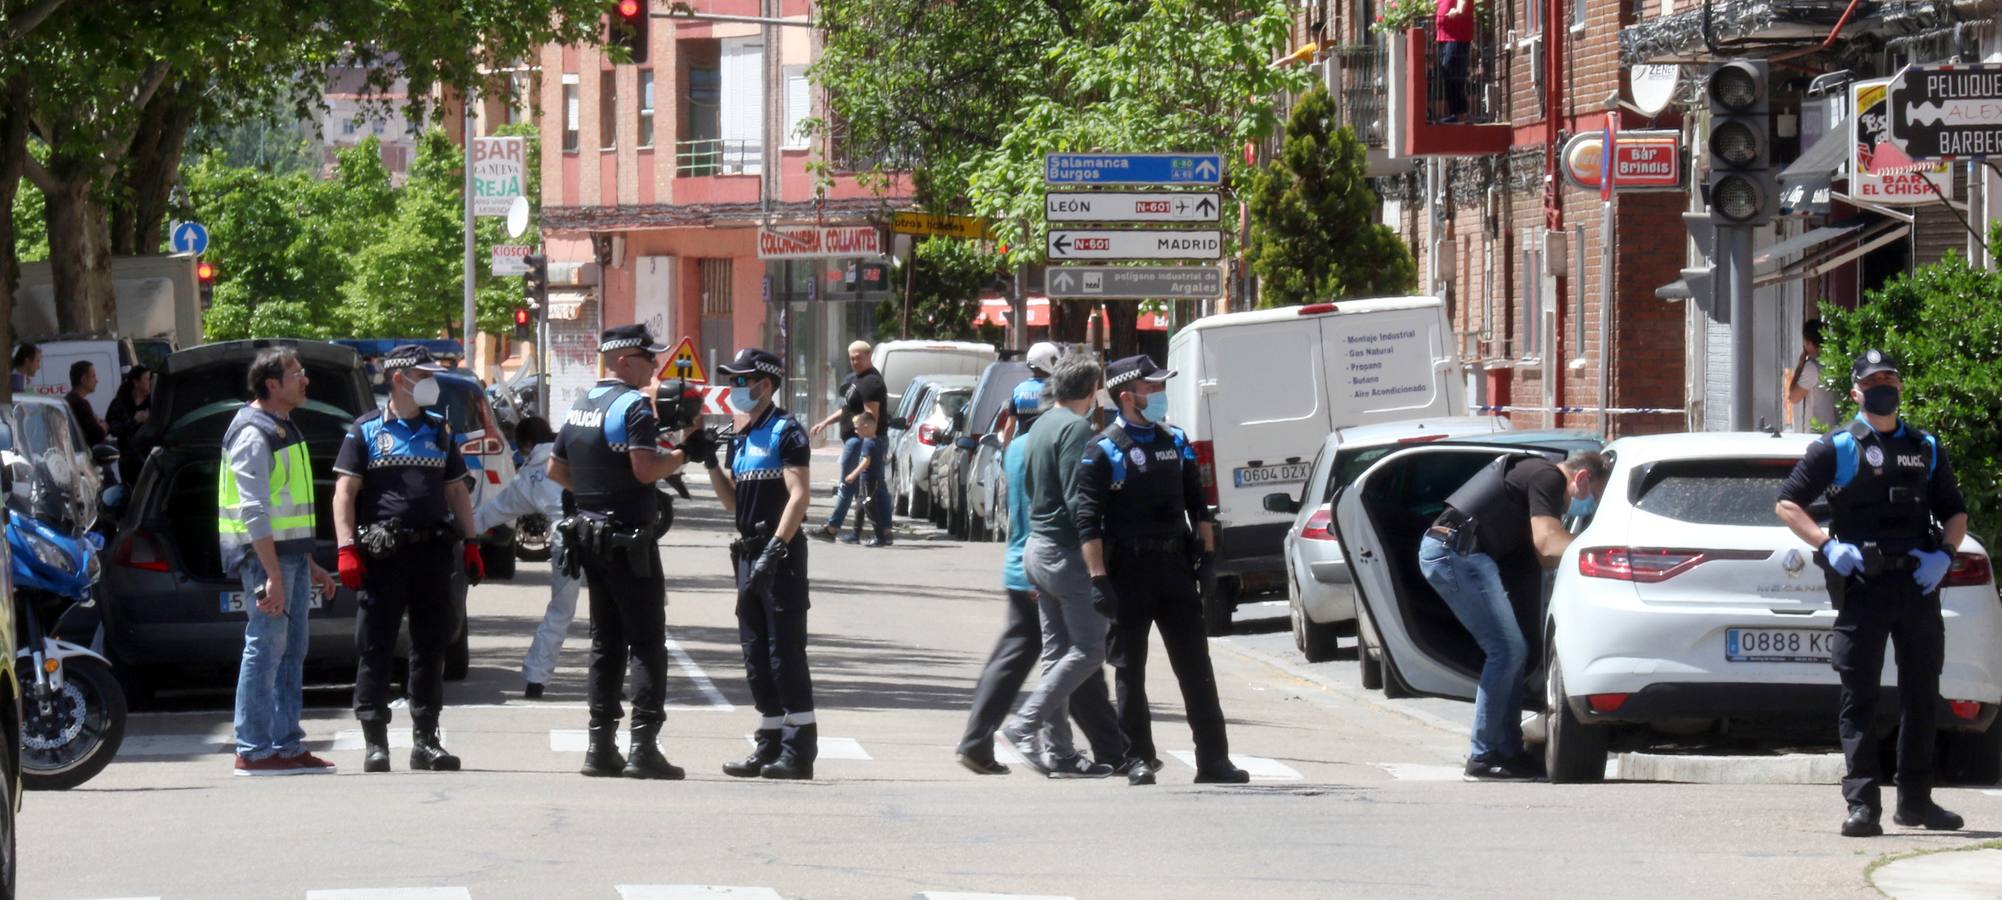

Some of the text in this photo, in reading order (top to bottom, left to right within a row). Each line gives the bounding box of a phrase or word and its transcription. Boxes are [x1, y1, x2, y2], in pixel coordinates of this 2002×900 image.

[1928, 74, 2002, 97] PELUQUE
[1940, 131, 2002, 154] BARBER
[473, 140, 521, 162] BAR
[1631, 148, 1657, 160] Bar
[1050, 157, 1129, 168] Salamanca
[1620, 161, 1669, 174] Brindis
[489, 164, 519, 176] NUEVA
[1050, 168, 1100, 180] Burgos
[1882, 175, 1923, 184] BAR
[474, 175, 521, 197] REJA
[1863, 184, 1942, 195] EL CHISPA
[1050, 198, 1091, 212] LEÓN
[826, 228, 877, 252] COLLANTES
[1158, 239, 1218, 250] MADRID
[493, 246, 530, 256] KIOSCO
[1114, 271, 1216, 281] polígono industrial de
[1171, 282, 1217, 293] Argales
[1347, 330, 1416, 343] Montaje Industrial
[1349, 346, 1394, 357] Gas Natural
[1350, 362, 1382, 371] Propano
[1352, 376, 1379, 385] Butano
[1354, 384, 1427, 398] Aire Acondicionado
[565, 408, 602, 427] POLICÍA
[1243, 464, 1307, 482] 0604 DZX
[1742, 633, 1800, 651] 0888
